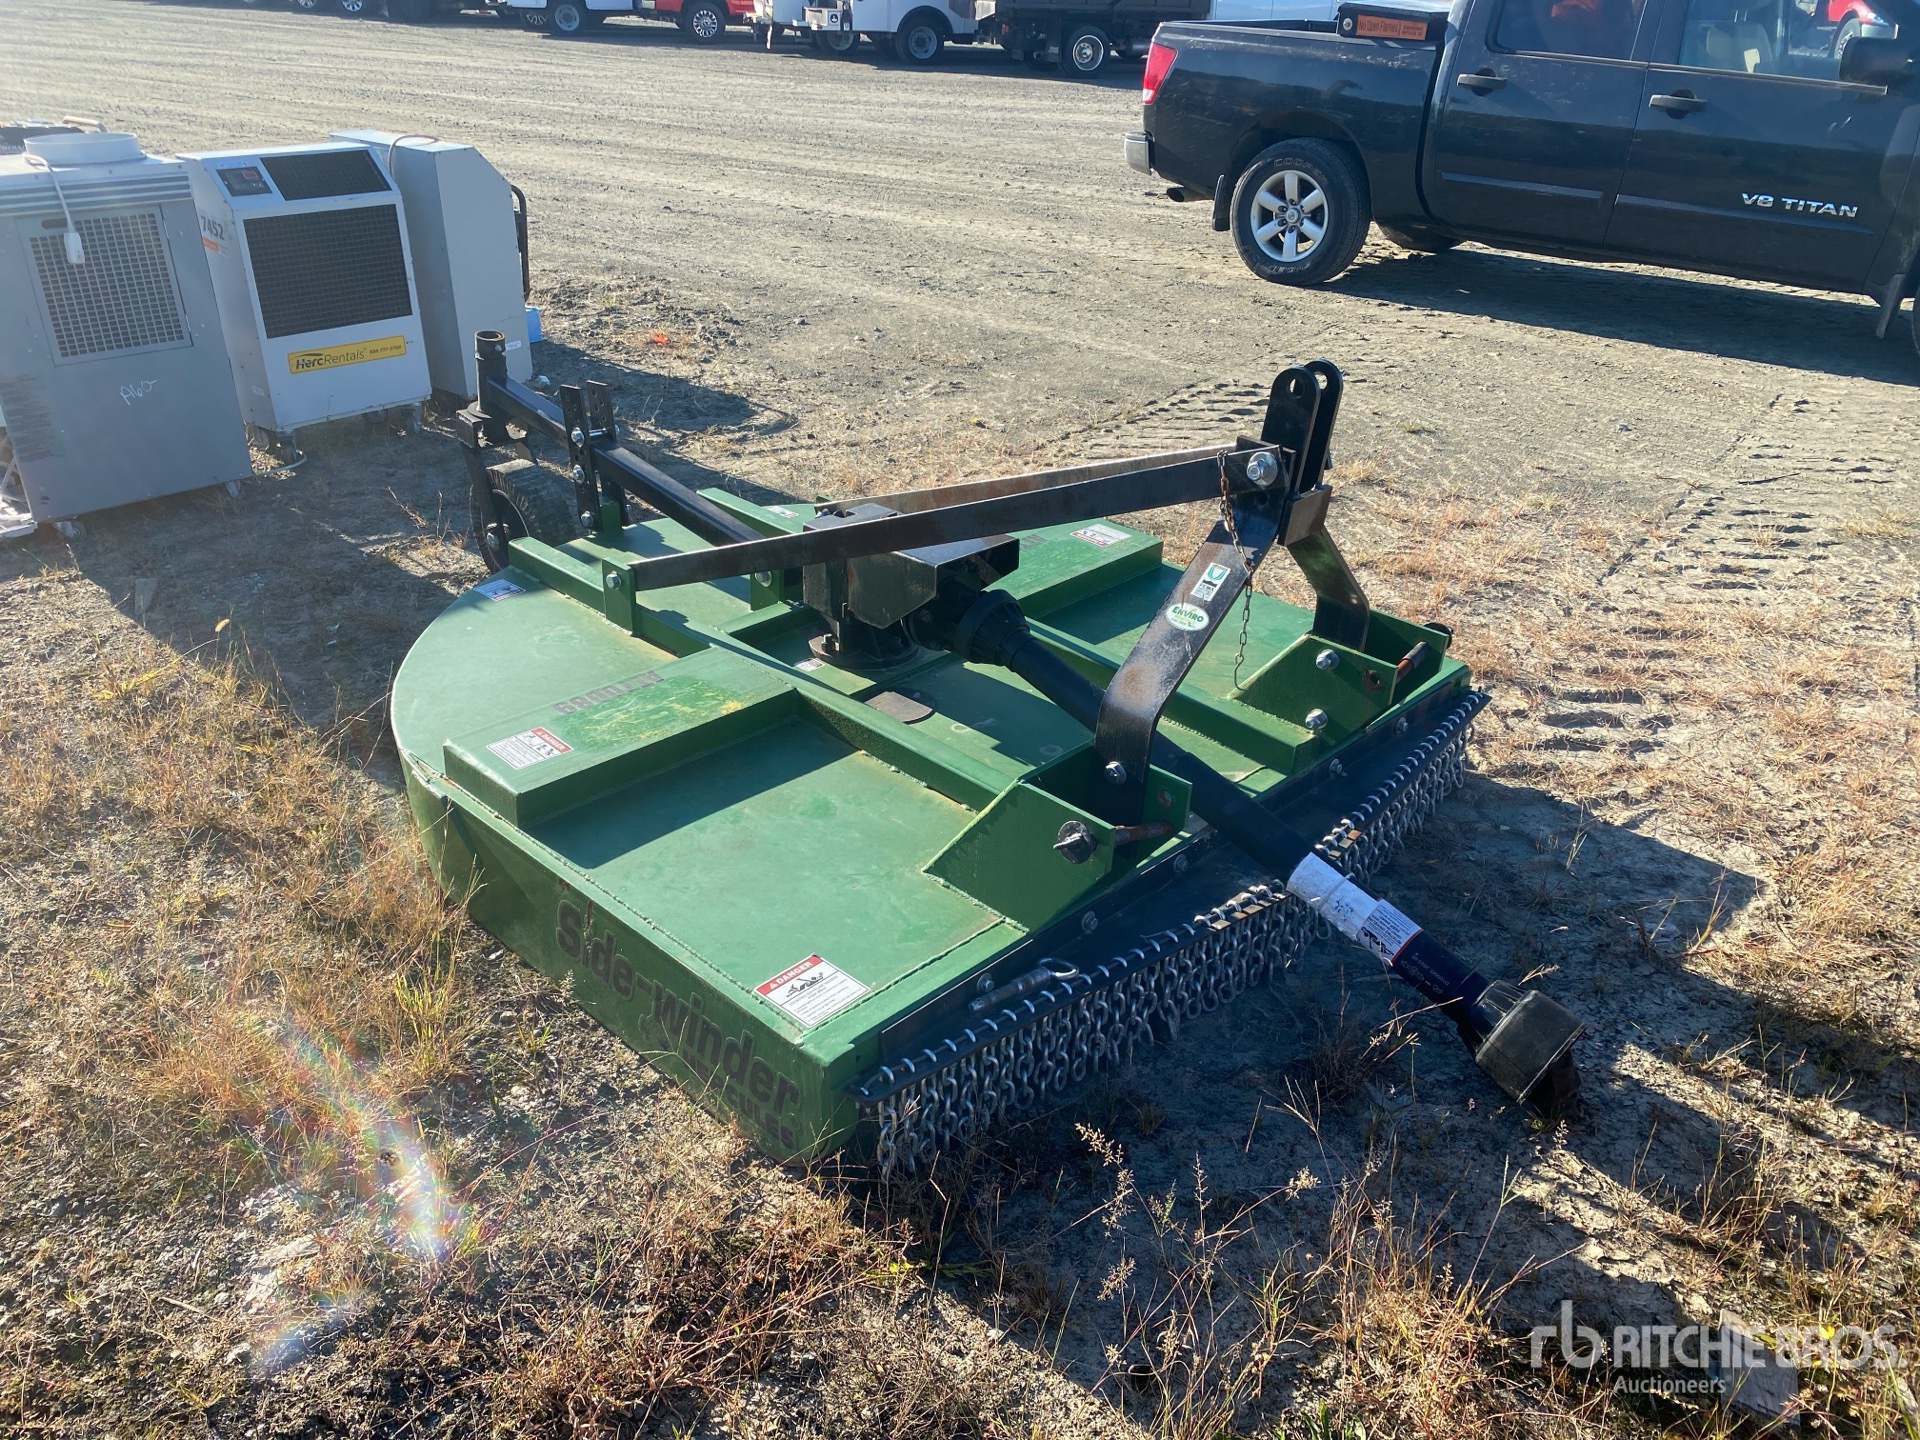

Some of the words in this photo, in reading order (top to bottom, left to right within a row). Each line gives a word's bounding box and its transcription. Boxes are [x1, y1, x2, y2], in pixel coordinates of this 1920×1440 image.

[1742, 193, 1775, 208] V8
[1781, 197, 1859, 218] TITAN
[200, 215, 225, 241] 7452
[296, 349, 365, 369] HercRentals
[1172, 606, 1204, 622] ENVIRO
[776, 961, 814, 985] DANGER
